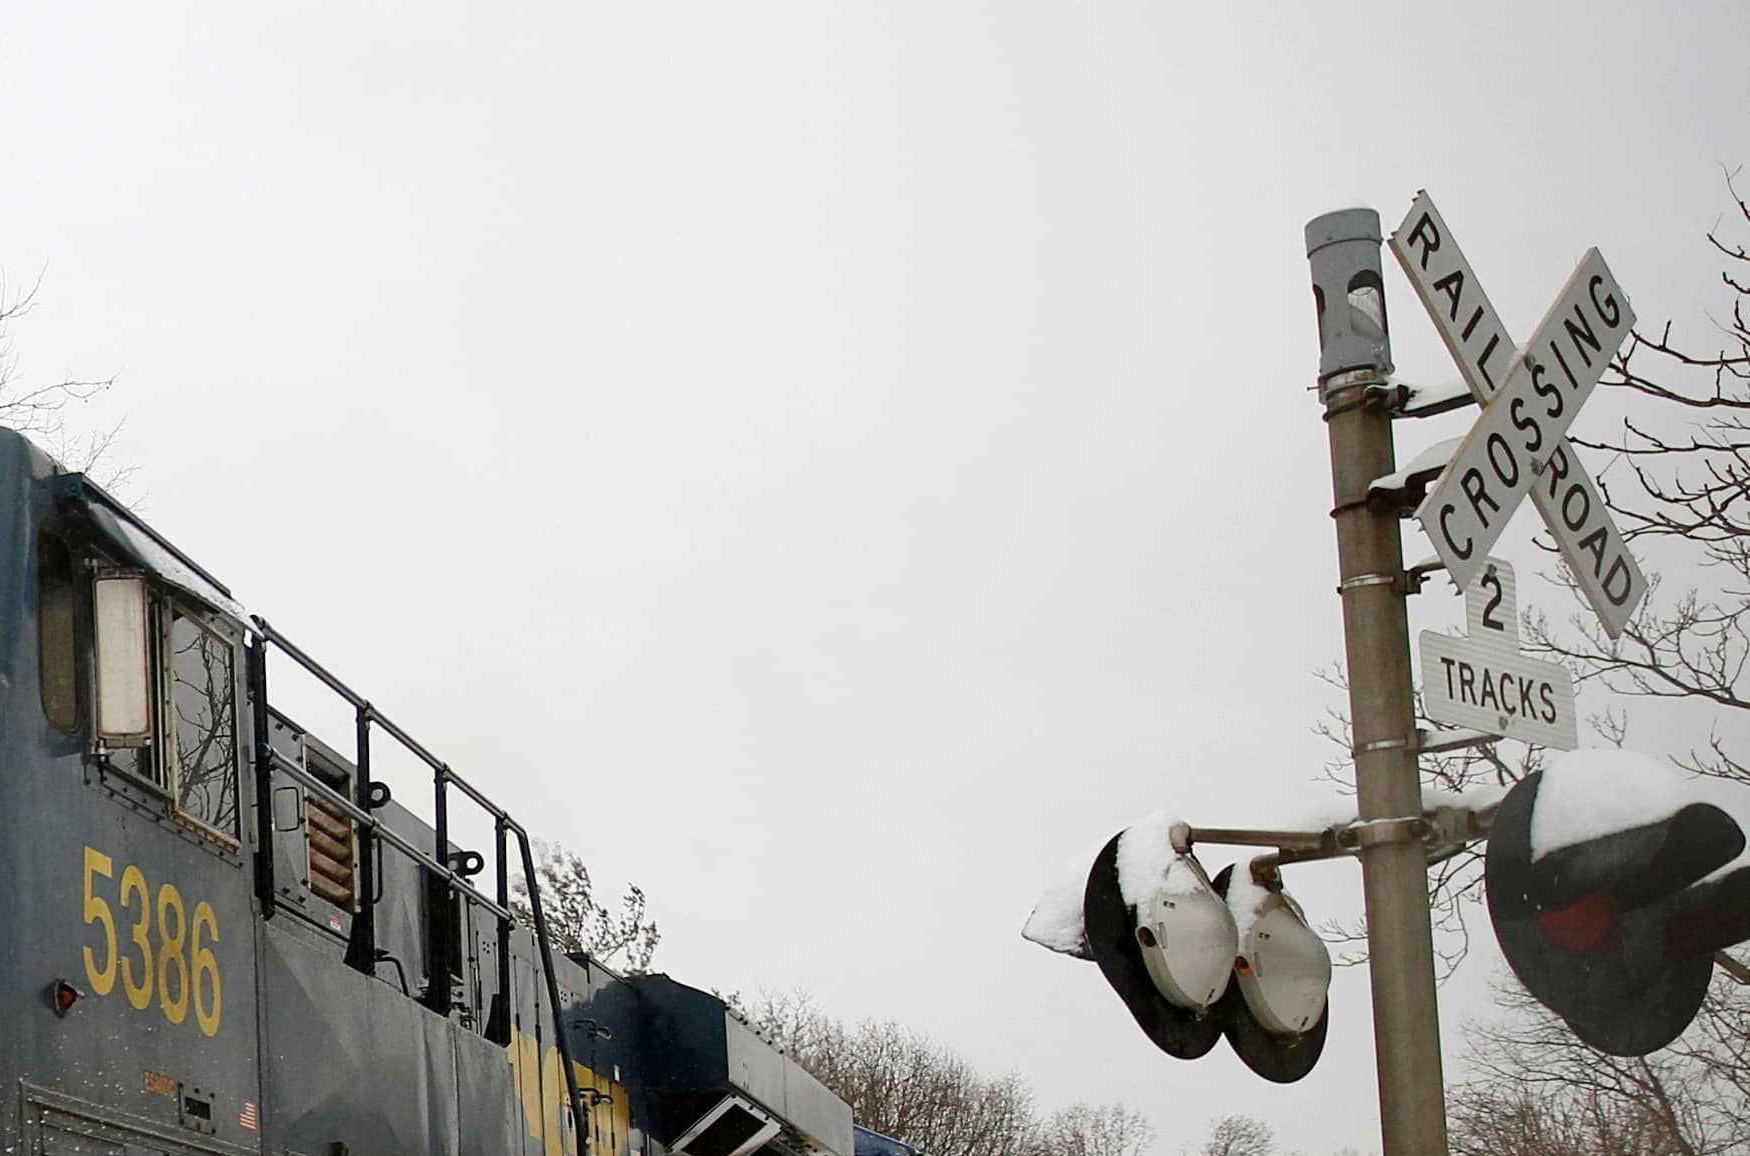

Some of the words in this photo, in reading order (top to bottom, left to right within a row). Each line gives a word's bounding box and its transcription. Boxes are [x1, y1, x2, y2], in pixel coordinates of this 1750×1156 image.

[1408, 211, 1502, 391] RAIL
[1547, 446, 1631, 607] ROAD
[1439, 274, 1621, 560] CROSSING
[1440, 657, 1557, 725] TRACKS
[1481, 575, 1504, 630] 2
[83, 847, 221, 1037] 5386
